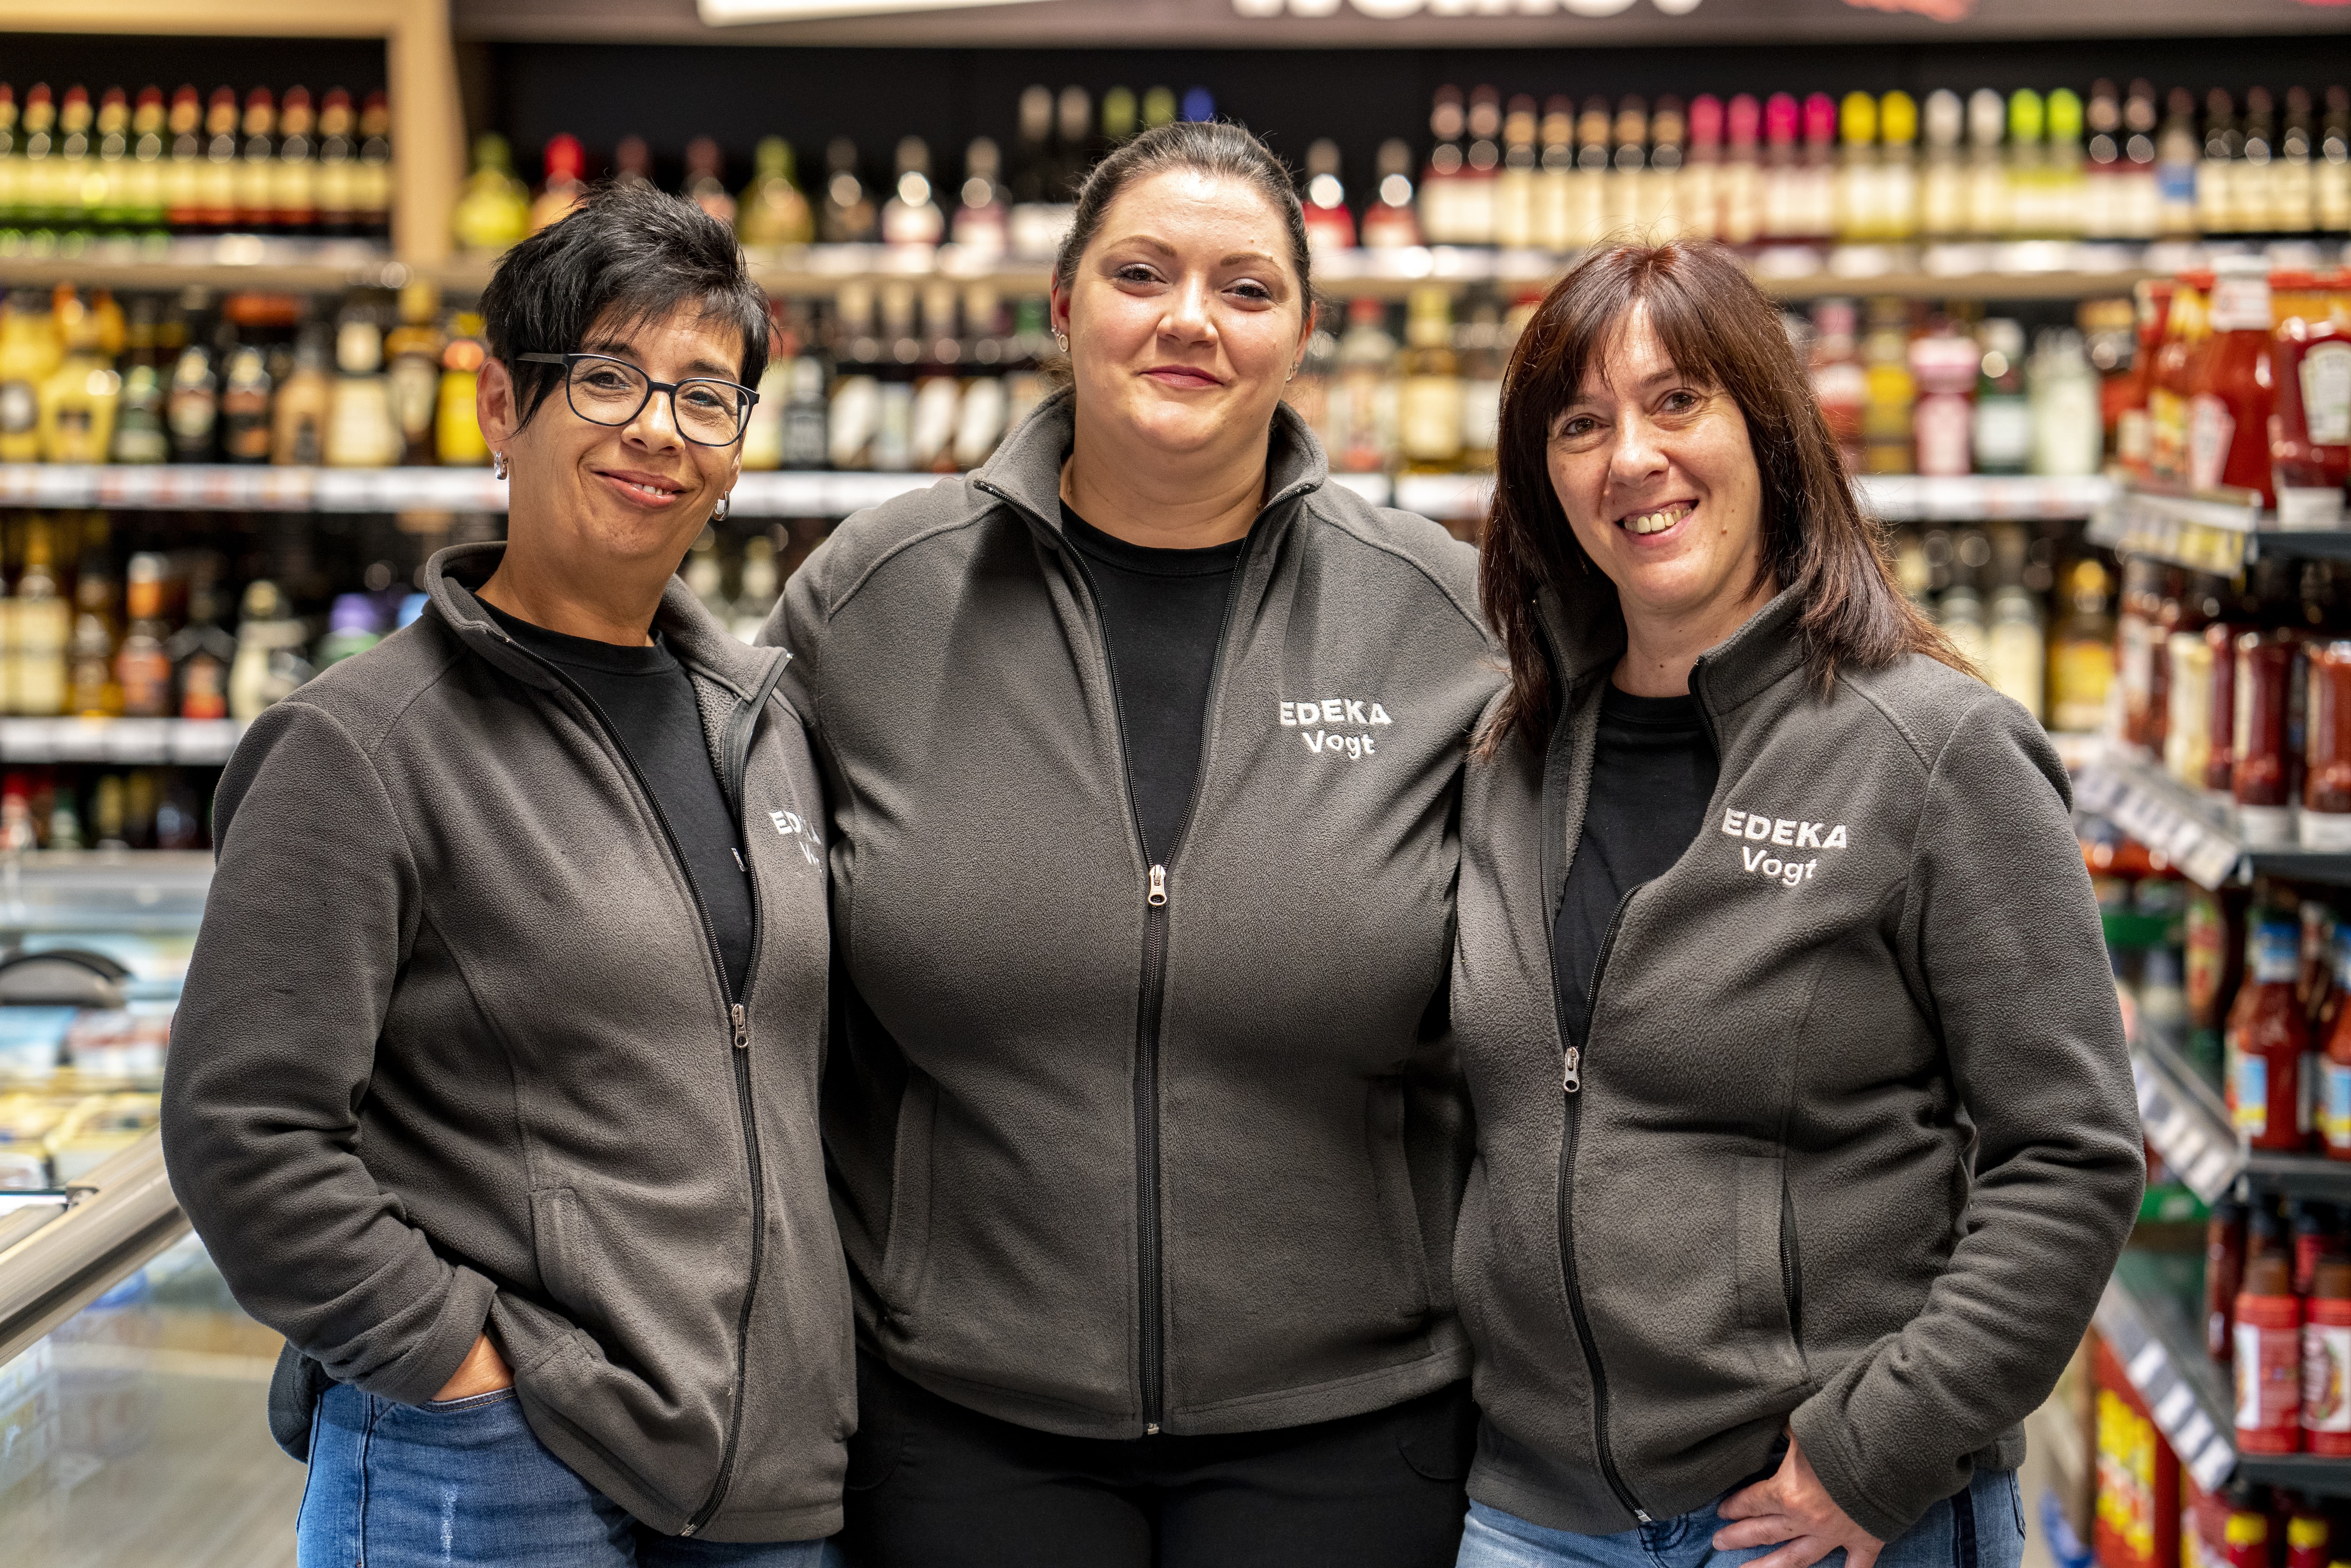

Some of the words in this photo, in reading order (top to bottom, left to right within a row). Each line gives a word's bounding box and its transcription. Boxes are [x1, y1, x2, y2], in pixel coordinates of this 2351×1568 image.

[1280, 699, 1392, 726] EDEKA
[1302, 730, 1375, 760] Vogt
[1722, 808, 1847, 848] EDEKA
[1743, 846, 1817, 886] Vogt
